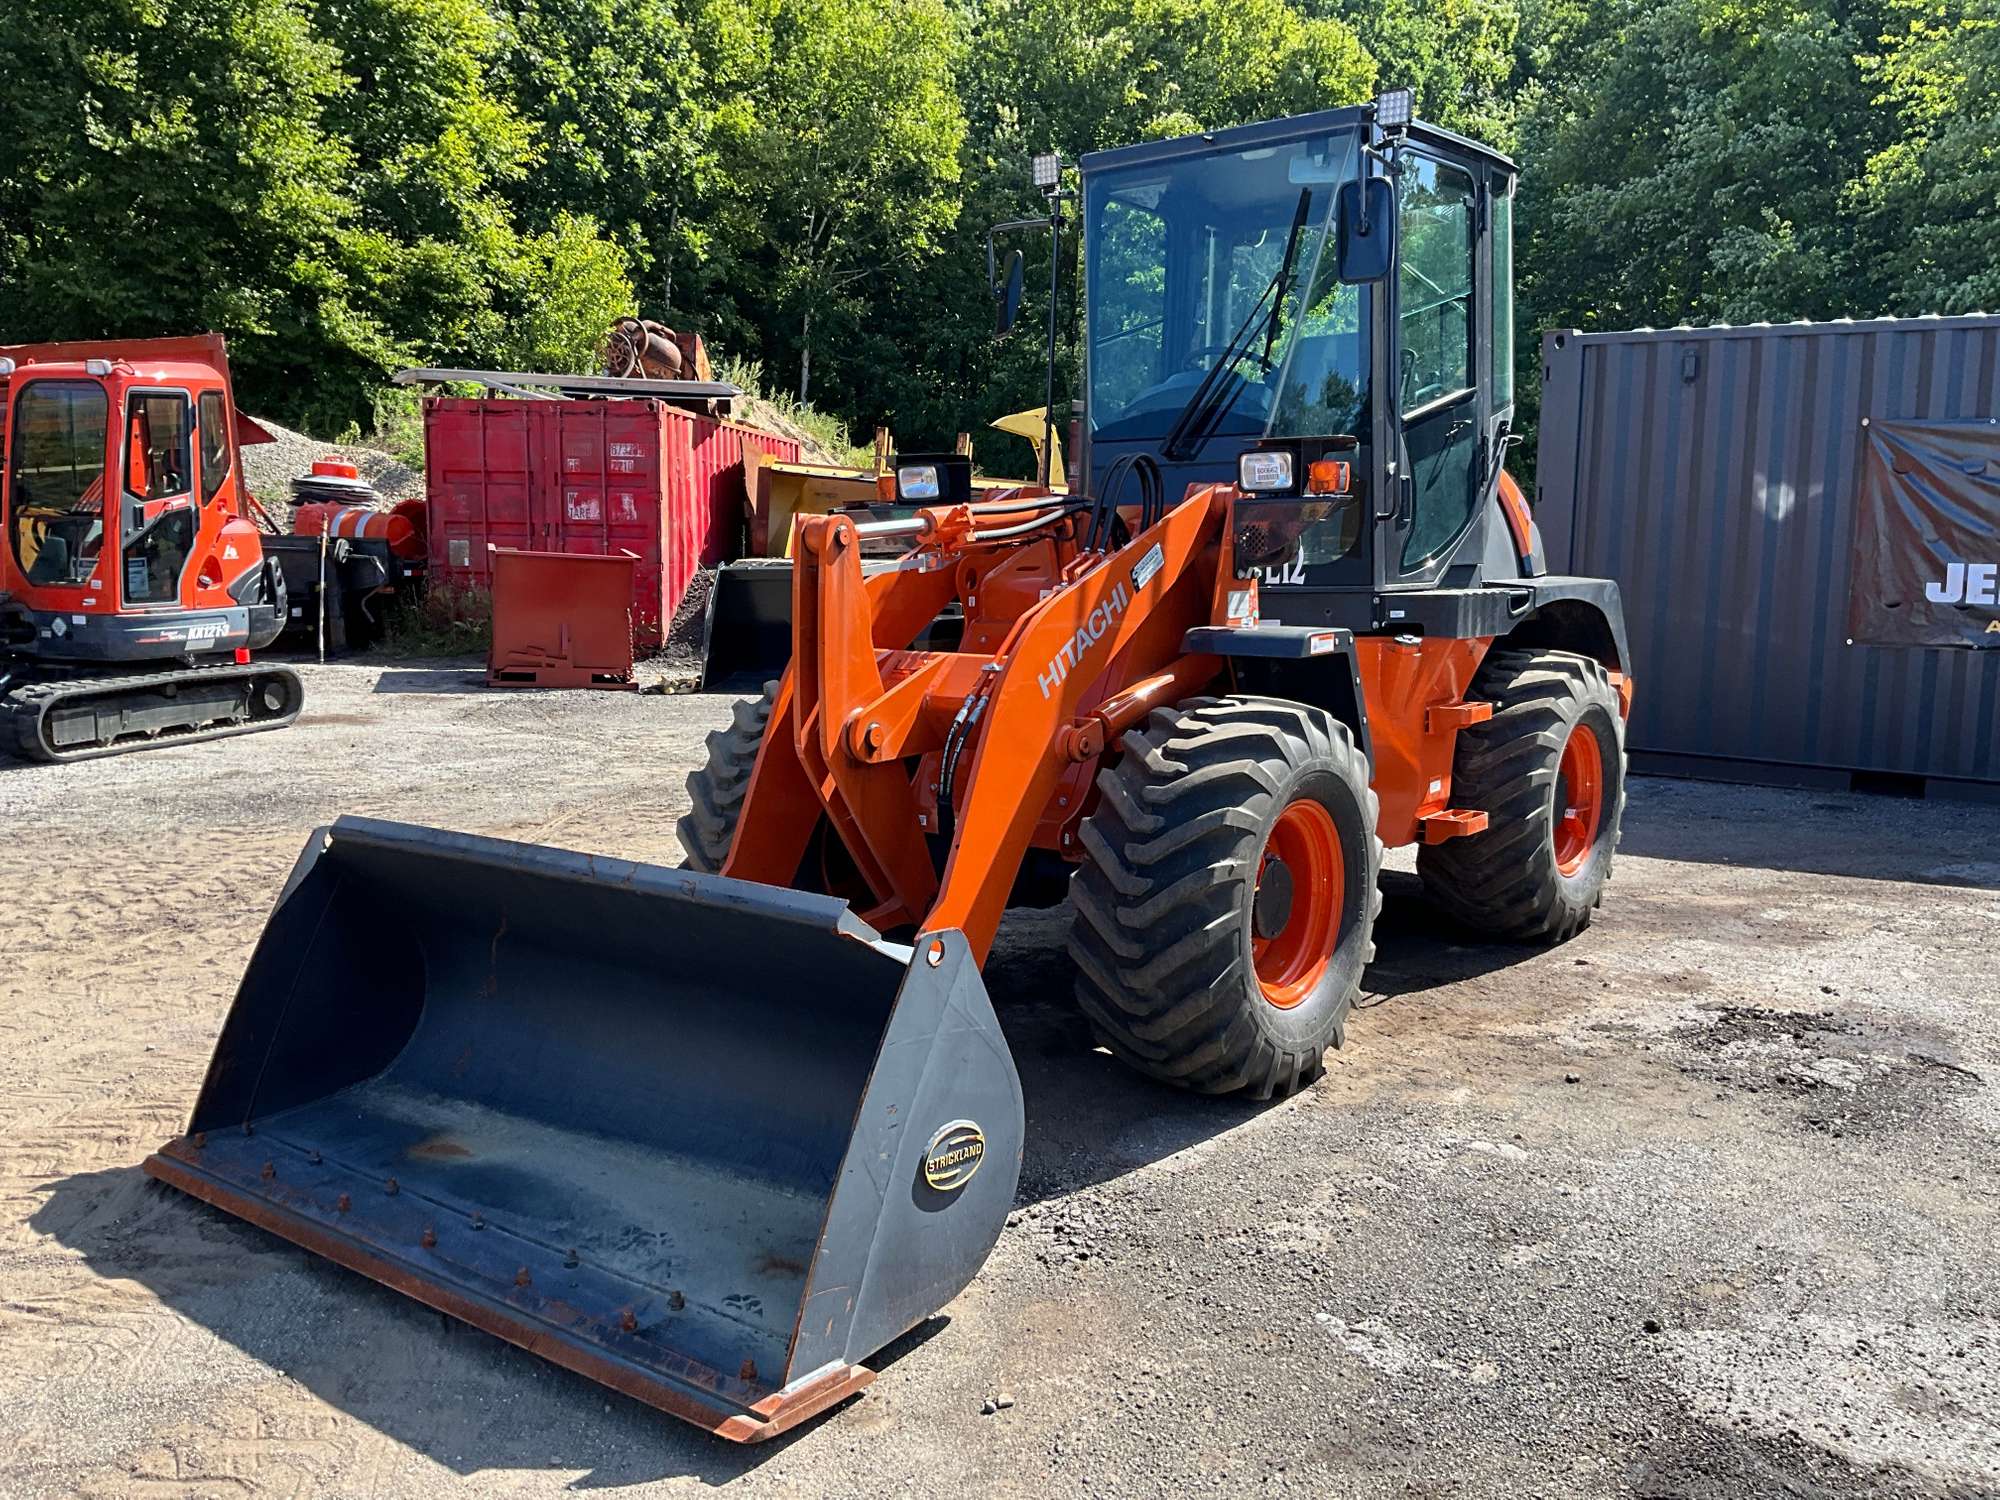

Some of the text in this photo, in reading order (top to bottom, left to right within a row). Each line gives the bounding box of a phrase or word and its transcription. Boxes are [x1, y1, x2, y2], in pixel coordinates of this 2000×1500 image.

[1926, 563, 2000, 605] JE
[1037, 581, 1129, 700] HITACHI
[928, 1143, 982, 1172] STRICKLAND
